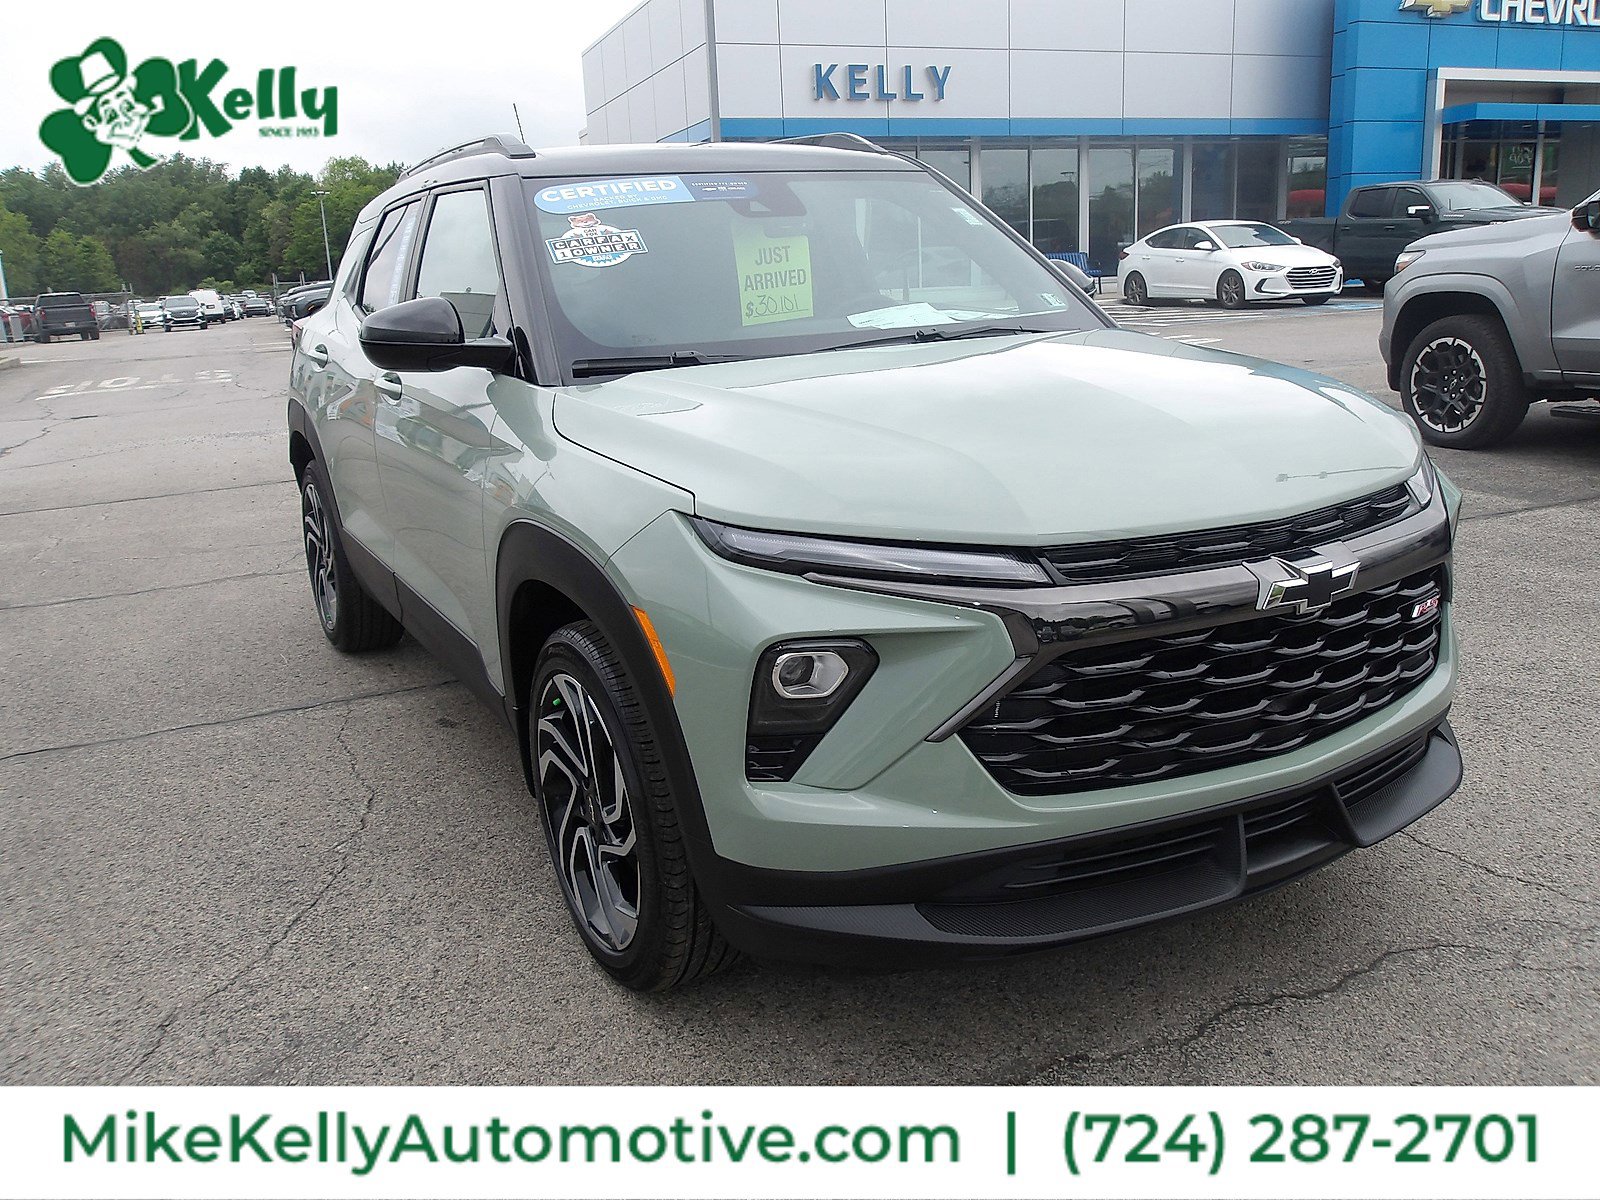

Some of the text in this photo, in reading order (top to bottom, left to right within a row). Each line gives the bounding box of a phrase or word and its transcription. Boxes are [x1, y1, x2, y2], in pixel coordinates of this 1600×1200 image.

[812, 63, 952, 101] KELLY
[541, 179, 678, 203] CERTIFIED
[593, 193, 625, 202] BACKED
[553, 235, 636, 250] CARFAX
[572, 241, 641, 257] OWNER
[754, 245, 791, 266] JUST
[744, 268, 807, 292] ARRIVED
